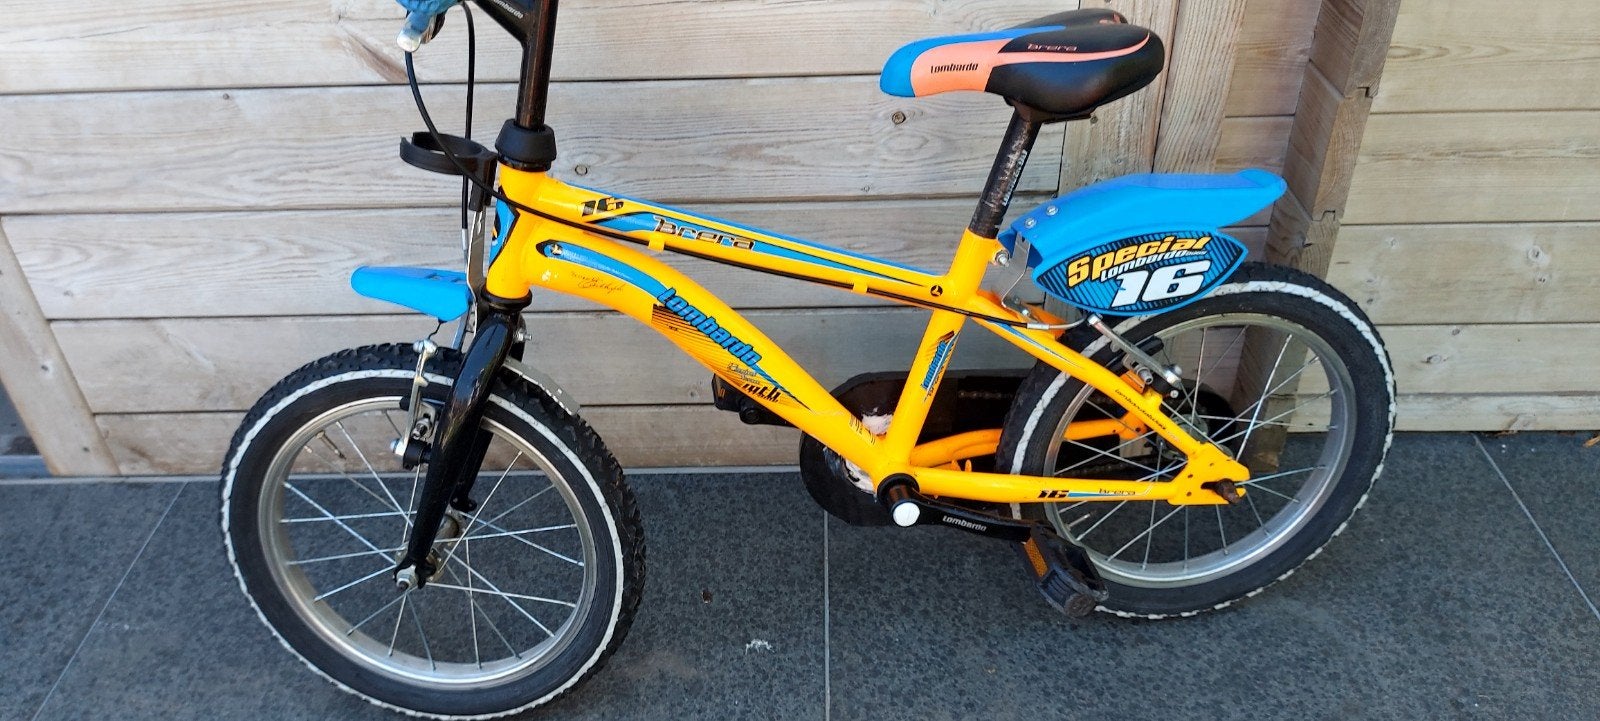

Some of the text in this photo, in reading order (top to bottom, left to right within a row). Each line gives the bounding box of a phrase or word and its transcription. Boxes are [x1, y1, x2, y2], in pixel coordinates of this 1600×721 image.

[582, 197, 624, 216] 16
[1067, 236, 1212, 288] Special
[1111, 260, 1212, 308] 16
[1038, 489, 1069, 499] 16
